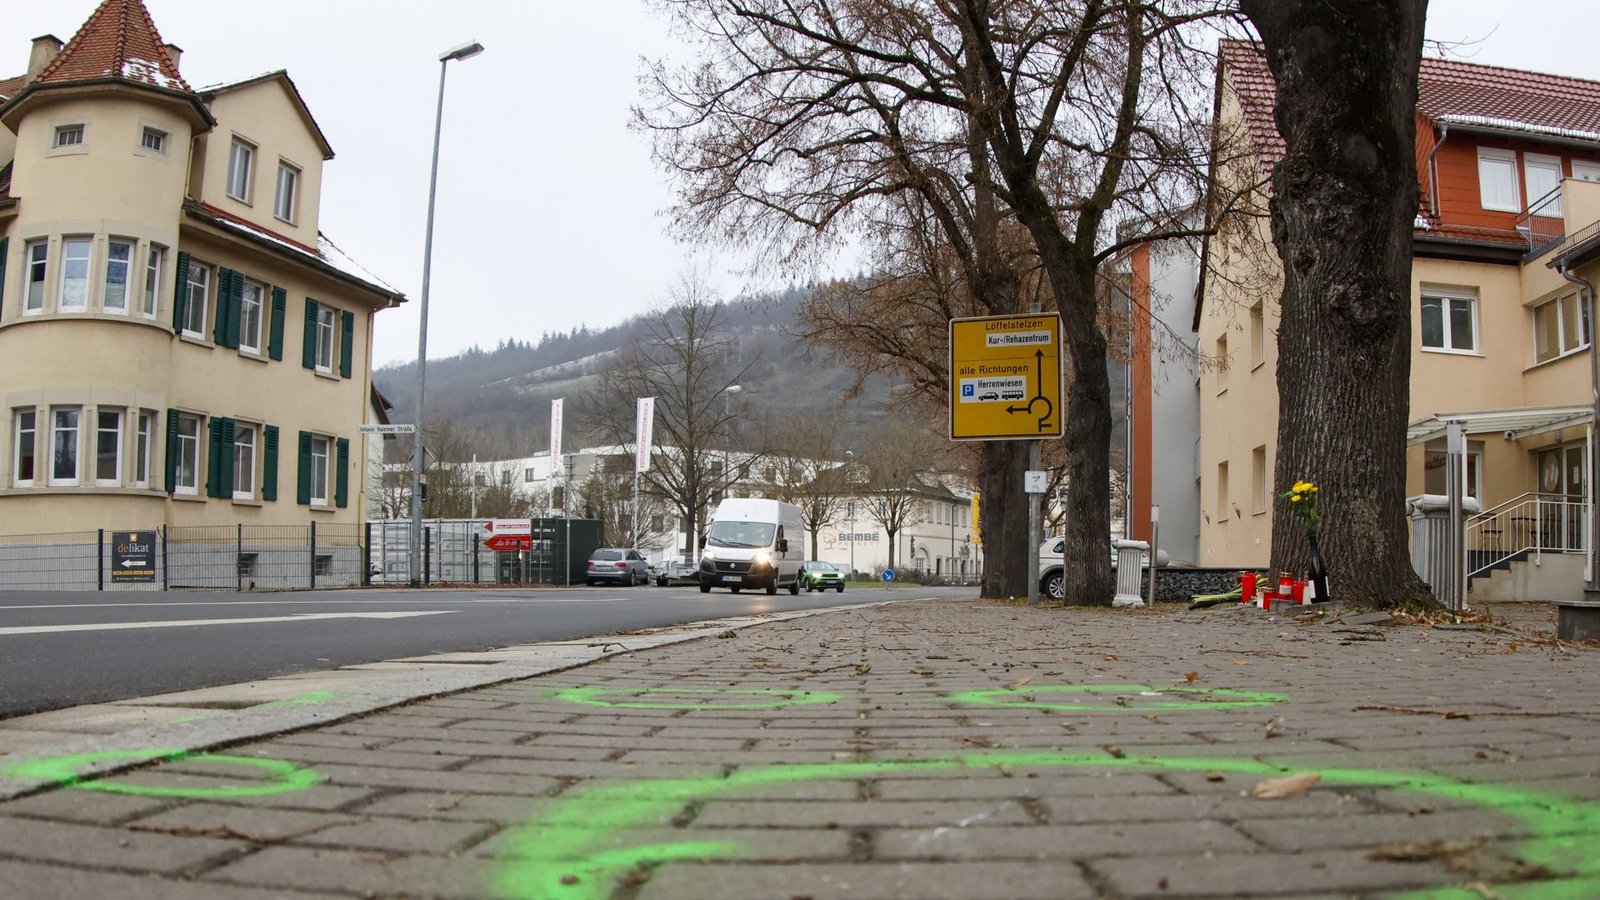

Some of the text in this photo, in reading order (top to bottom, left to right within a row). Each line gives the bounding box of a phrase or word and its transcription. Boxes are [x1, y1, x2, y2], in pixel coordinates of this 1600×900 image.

[985, 320, 1043, 331] Löffelstelzen
[988, 334, 1049, 345] Kur-/Rehazentrum
[960, 365, 1029, 375] alle Richtungen
[977, 379, 1023, 389] Herrenwiesen
[964, 385, 972, 396] P
[117, 543, 149, 553] delikat
